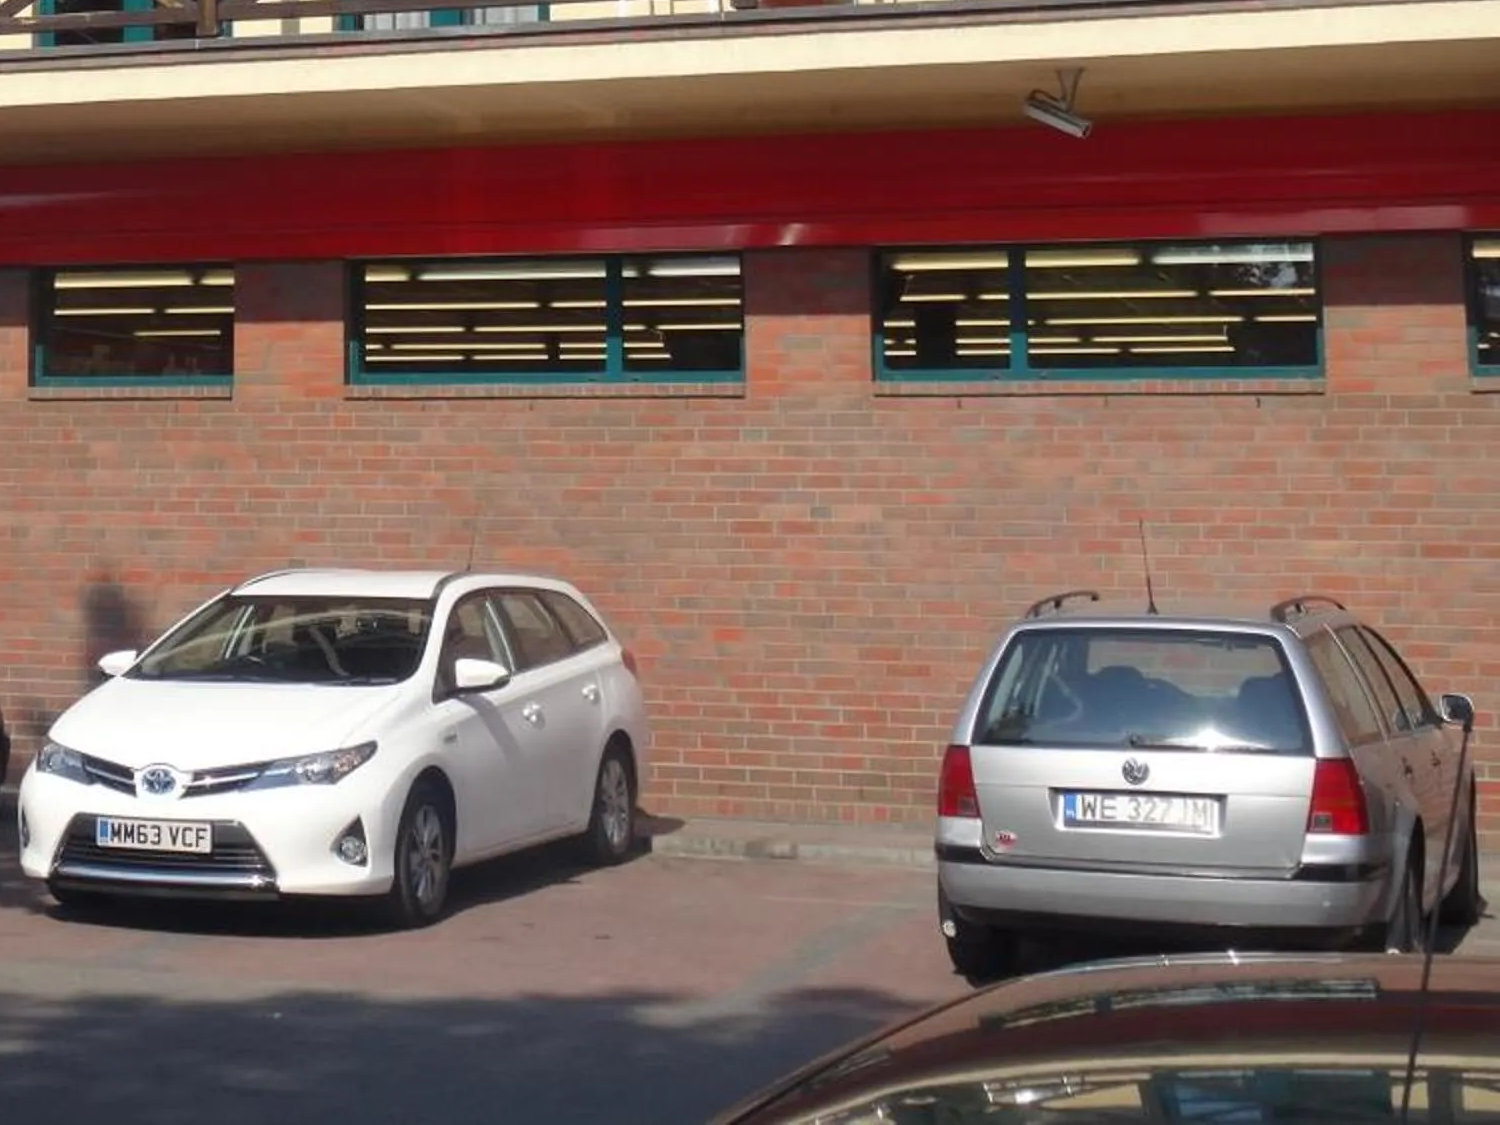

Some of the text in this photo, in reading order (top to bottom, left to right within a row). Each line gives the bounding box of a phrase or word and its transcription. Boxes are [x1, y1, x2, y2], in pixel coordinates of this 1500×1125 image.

[1081, 794, 1117, 820] WE
[110, 821, 208, 848] MM63 VCF
